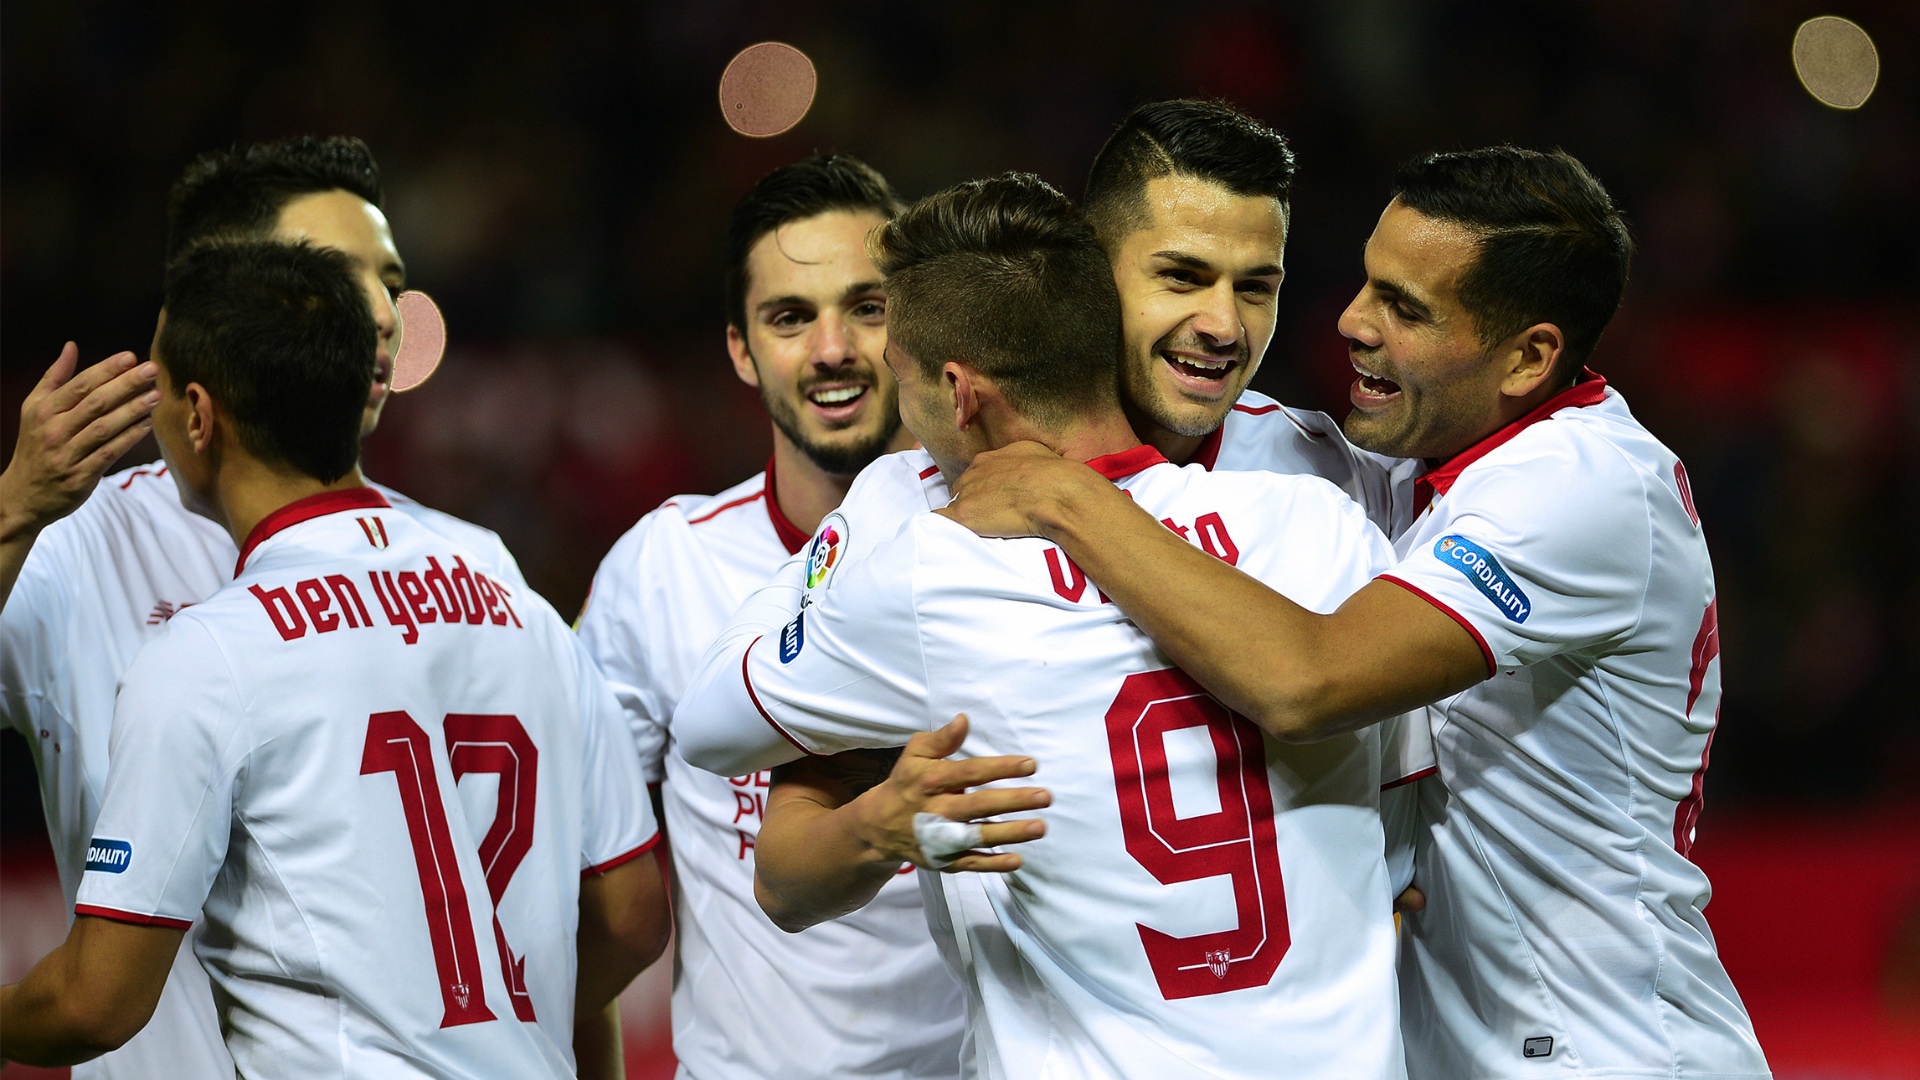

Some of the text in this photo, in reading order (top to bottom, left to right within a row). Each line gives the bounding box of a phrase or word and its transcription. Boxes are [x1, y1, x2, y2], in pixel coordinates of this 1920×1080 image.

[1451, 545, 1528, 619] CORDIALITY
[86, 846, 129, 866] DIALITY
[359, 709, 539, 1029] 12
[1104, 666, 1292, 1001] 9
